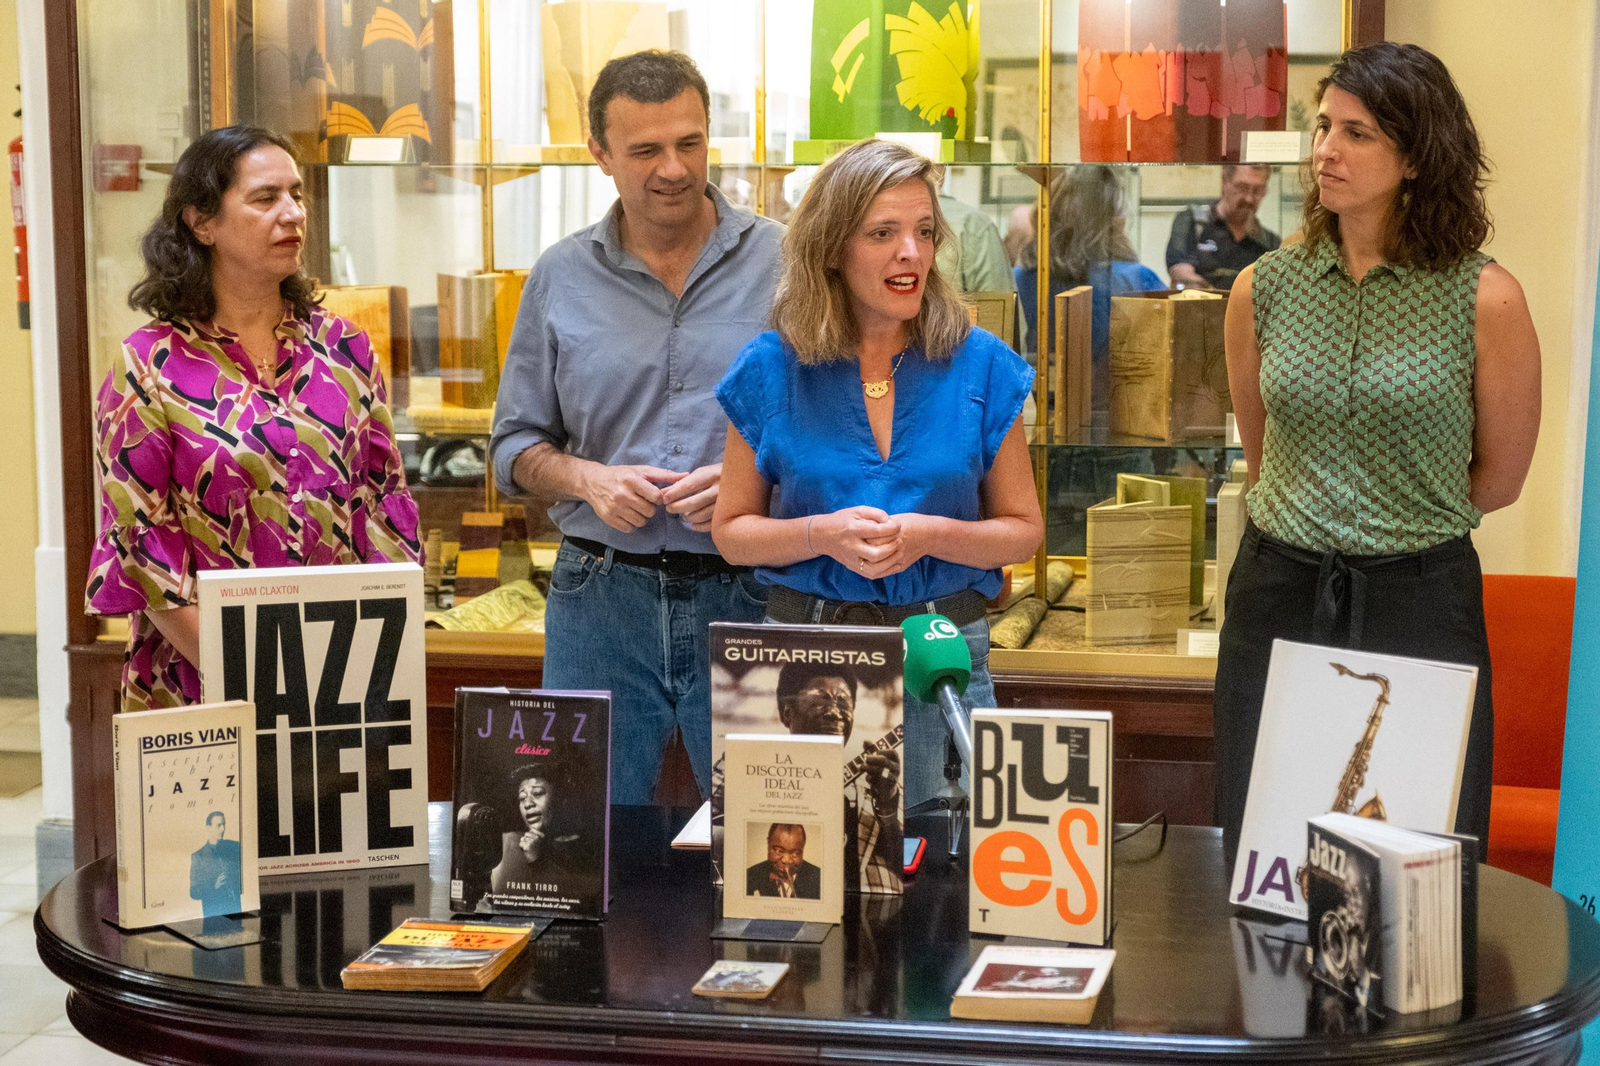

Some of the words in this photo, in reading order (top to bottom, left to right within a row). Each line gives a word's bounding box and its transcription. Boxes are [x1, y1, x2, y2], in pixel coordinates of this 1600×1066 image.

[220, 586, 257, 597] WILLIAM
[259, 584, 299, 596] CLAXTON
[724, 637, 763, 646] GRANDES
[724, 646, 887, 667] GUITARRISTAS
[221, 597, 412, 731] JAZZ
[509, 699, 541, 709] HISTORIA
[543, 700, 556, 709] DEL
[477, 708, 588, 744] JAZZ
[142, 730, 194, 750] BORIS
[198, 726, 238, 743] VIAN
[514, 742, 551, 756] clásico
[775, 753, 793, 765] LA
[745, 764, 822, 780] DISCOTECA
[147, 774, 236, 798] JAZZ
[256, 723, 415, 859] LIFE
[764, 777, 804, 791] IDEAL
[765, 791, 782, 799] DEL
[783, 791, 803, 800] JAZZ
[367, 853, 400, 862] TASCHEN
[1309, 831, 1347, 881] Jazz
[311, 860, 337, 868] AMERICA
[1236, 849, 1296, 904] JA
[506, 881, 532, 891] FRANK
[535, 882, 559, 893] TIRRO
[1251, 897, 1281, 911] HISTORIA
[978, 908, 990, 923] T
